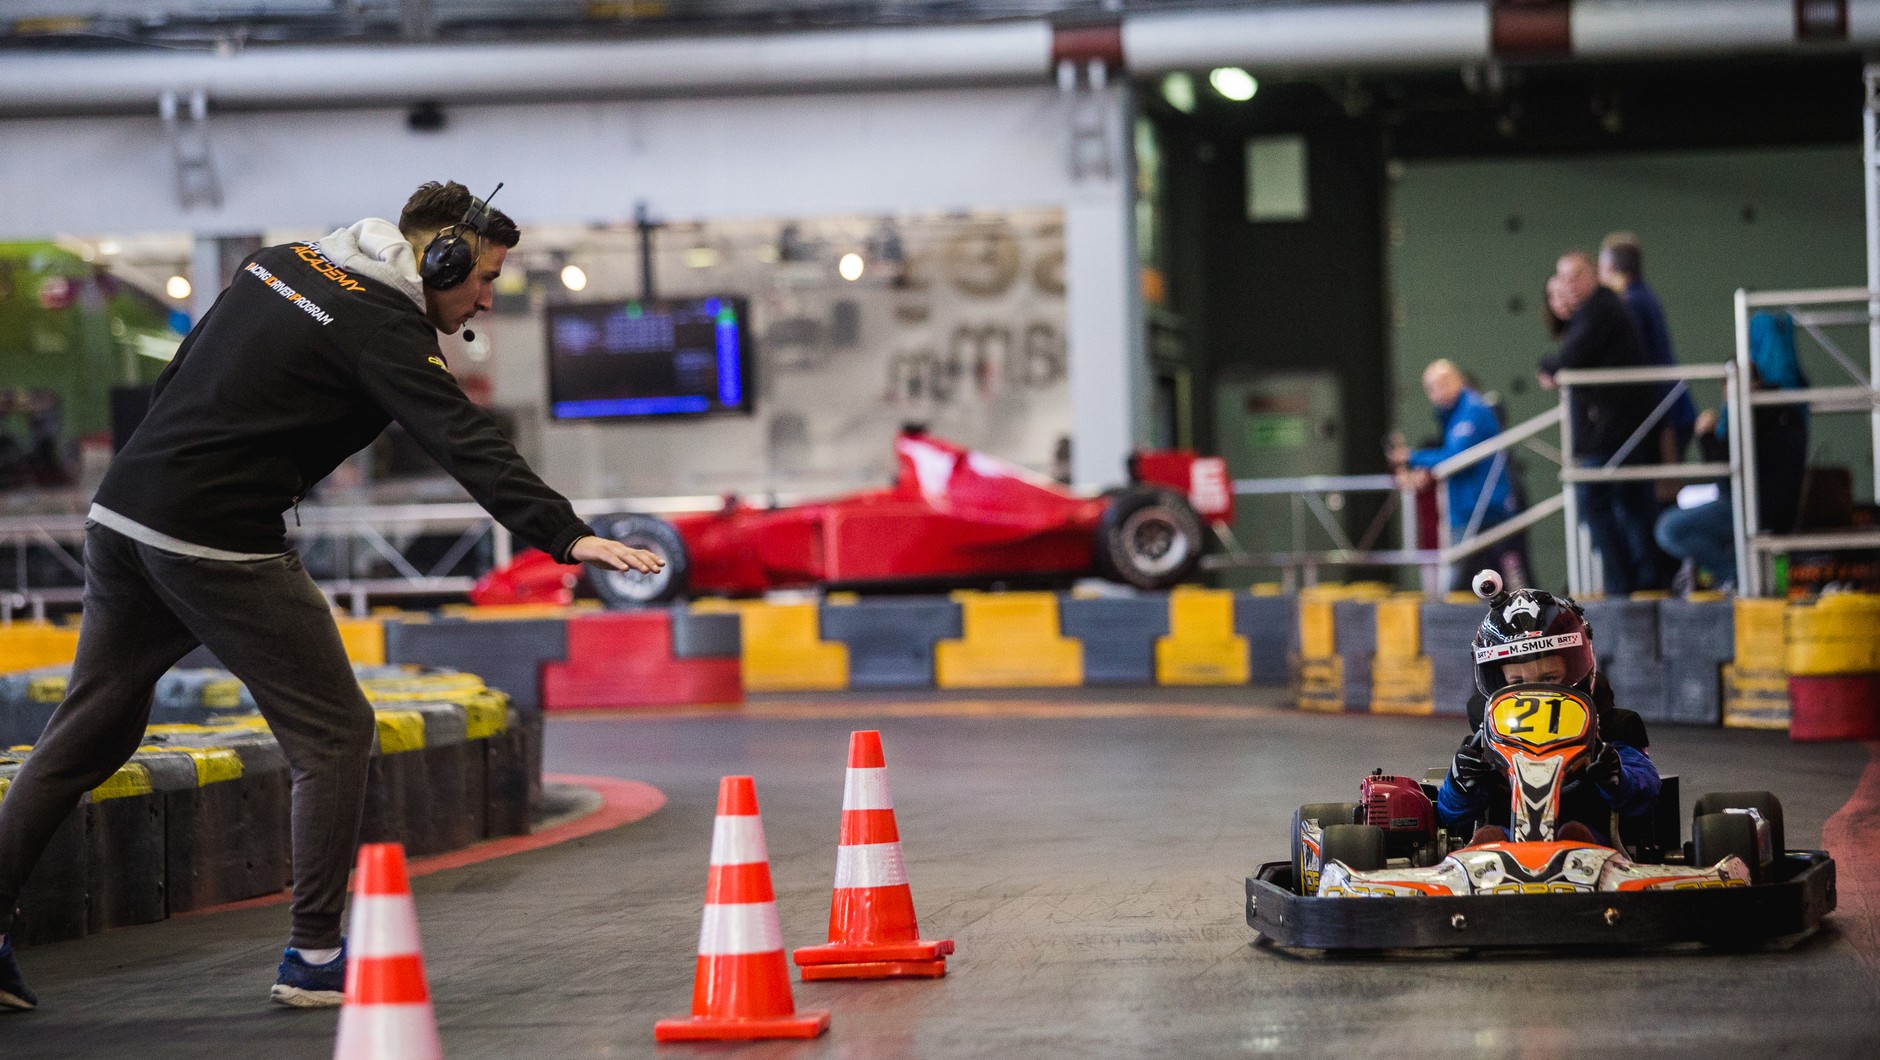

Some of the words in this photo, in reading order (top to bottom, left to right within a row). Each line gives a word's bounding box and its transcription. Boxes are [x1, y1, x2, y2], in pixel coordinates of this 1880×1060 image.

[290, 246, 366, 291] ACADEMY
[1510, 639, 1553, 654] M.SMUK
[1510, 698, 1562, 734] 21
